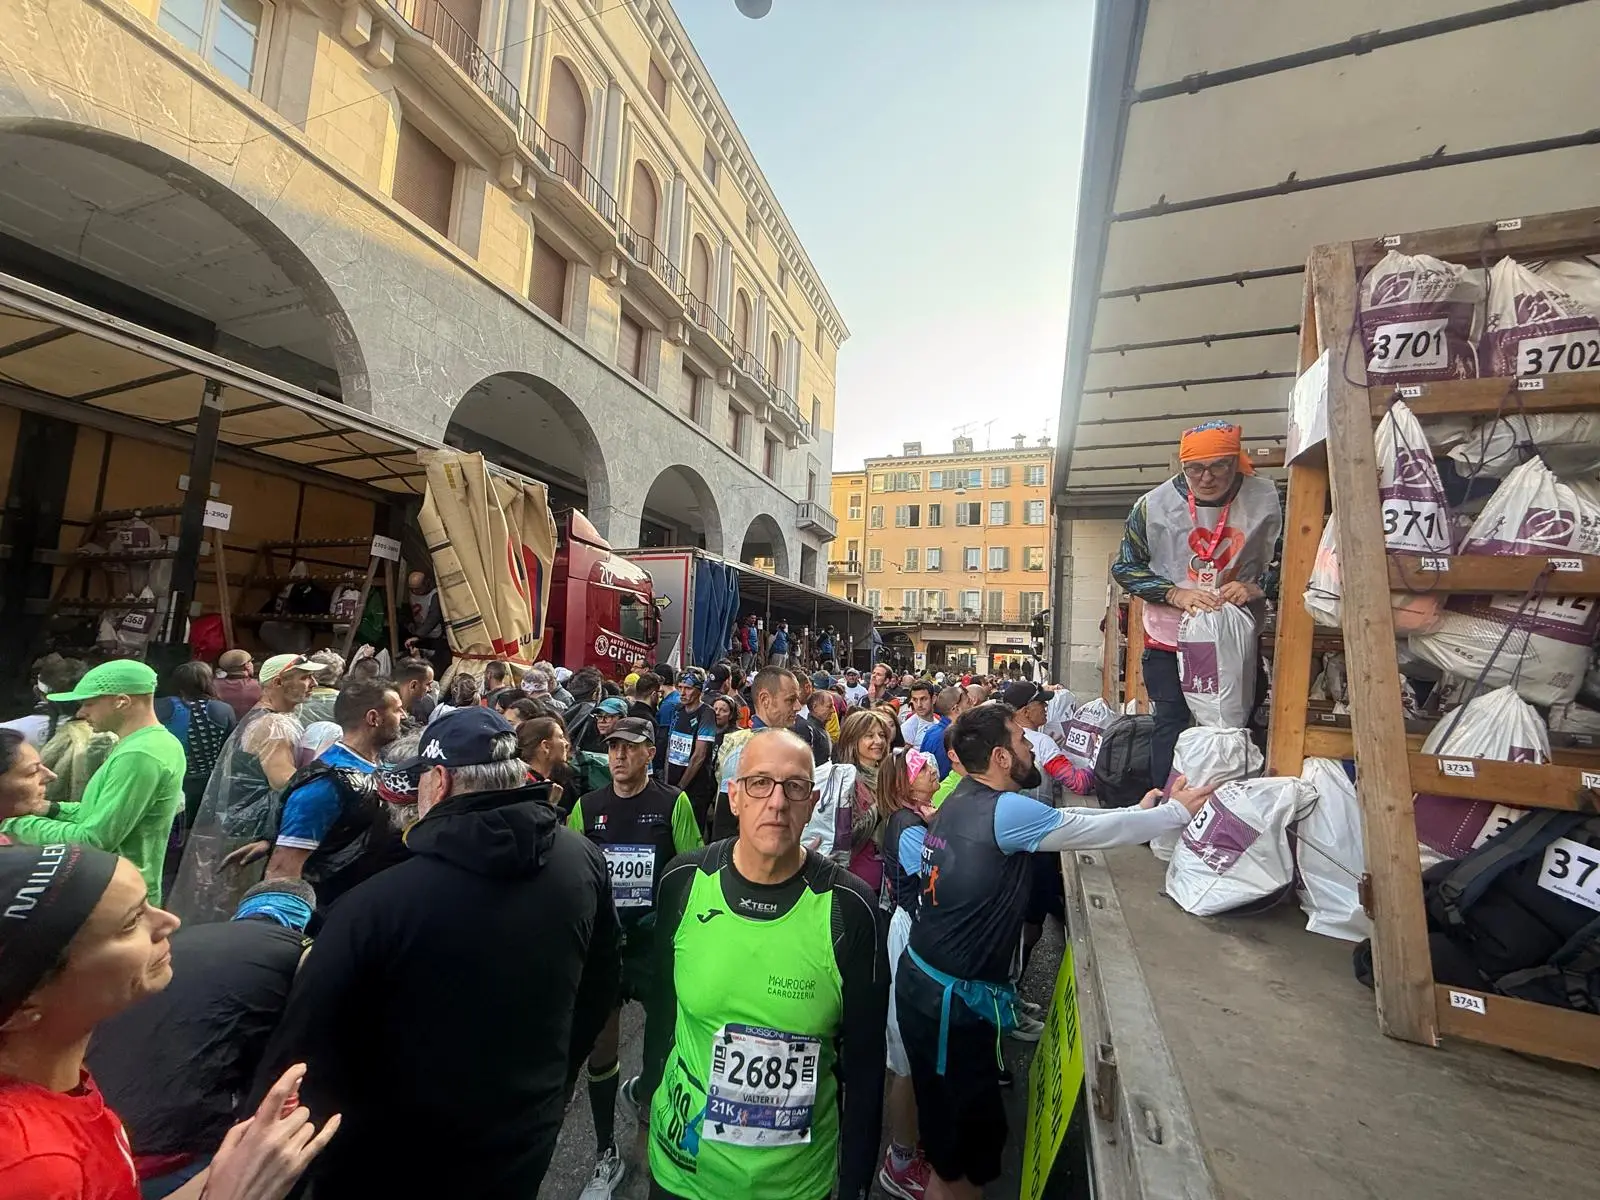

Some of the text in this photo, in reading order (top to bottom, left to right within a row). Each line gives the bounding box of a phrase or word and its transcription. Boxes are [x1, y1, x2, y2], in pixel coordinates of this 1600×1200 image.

[1377, 330, 1441, 360] 3701
[1523, 340, 1600, 375] 3702
[125, 615, 144, 625] 368
[1446, 763, 1471, 772] 3731
[1548, 848, 1600, 895] 37
[768, 974, 817, 991] MAUROCAR
[767, 987, 816, 1000] CARROZZERIA
[1454, 995, 1480, 1009] 3741
[745, 1026, 785, 1039] BOSSONI
[728, 1050, 799, 1090] 2685
[743, 1094, 770, 1104] VALTER
[711, 1100, 736, 1117] 21K
